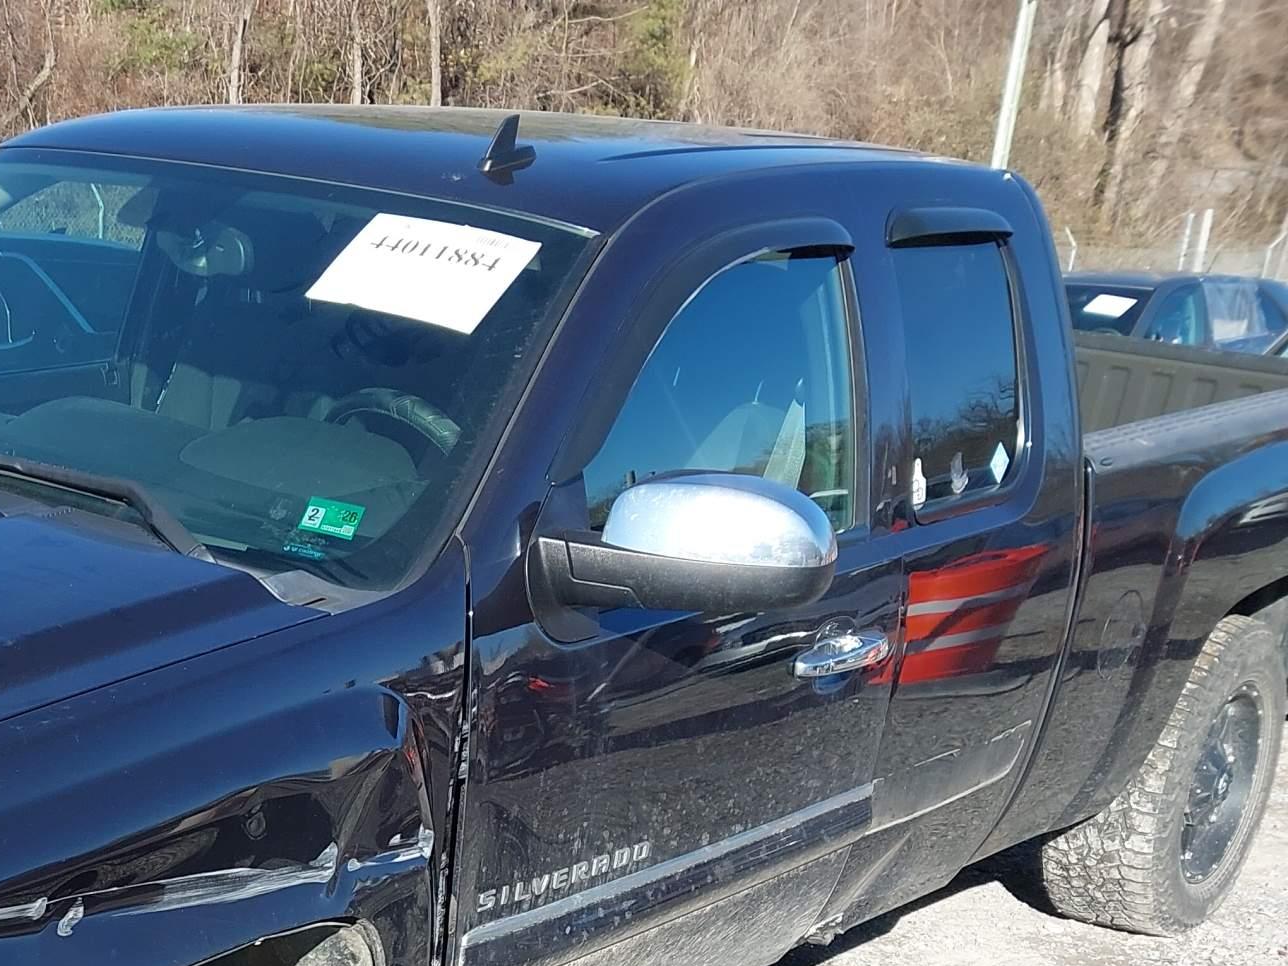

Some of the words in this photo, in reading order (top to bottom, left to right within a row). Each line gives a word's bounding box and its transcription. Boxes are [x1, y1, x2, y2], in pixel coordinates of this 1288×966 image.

[370, 235, 501, 271] 44011884
[308, 507, 320, 522] 2
[476, 840, 651, 913] SILVERADO
